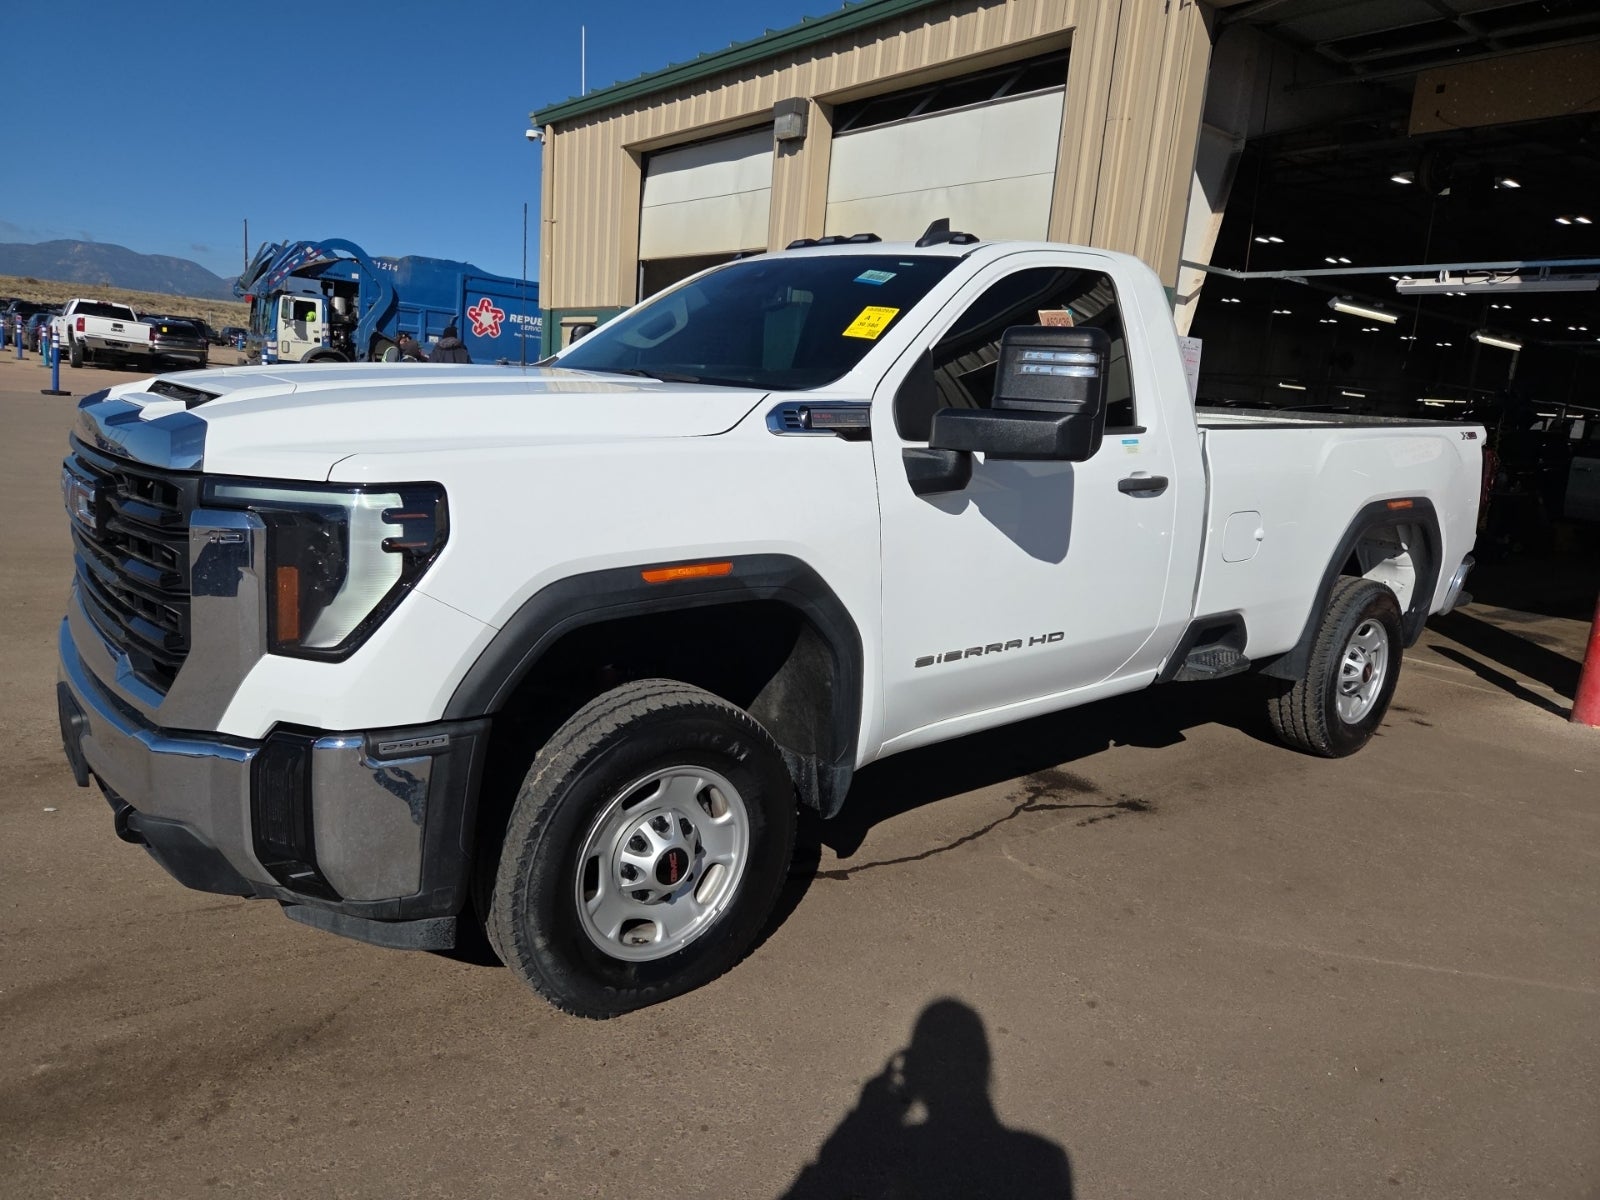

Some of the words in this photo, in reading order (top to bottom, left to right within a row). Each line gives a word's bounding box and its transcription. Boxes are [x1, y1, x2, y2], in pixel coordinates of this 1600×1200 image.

[914, 639, 1023, 668] SIERRA
[1028, 631, 1065, 647] HD
[383, 738, 445, 751] 2500
[669, 852, 679, 882] GMC
